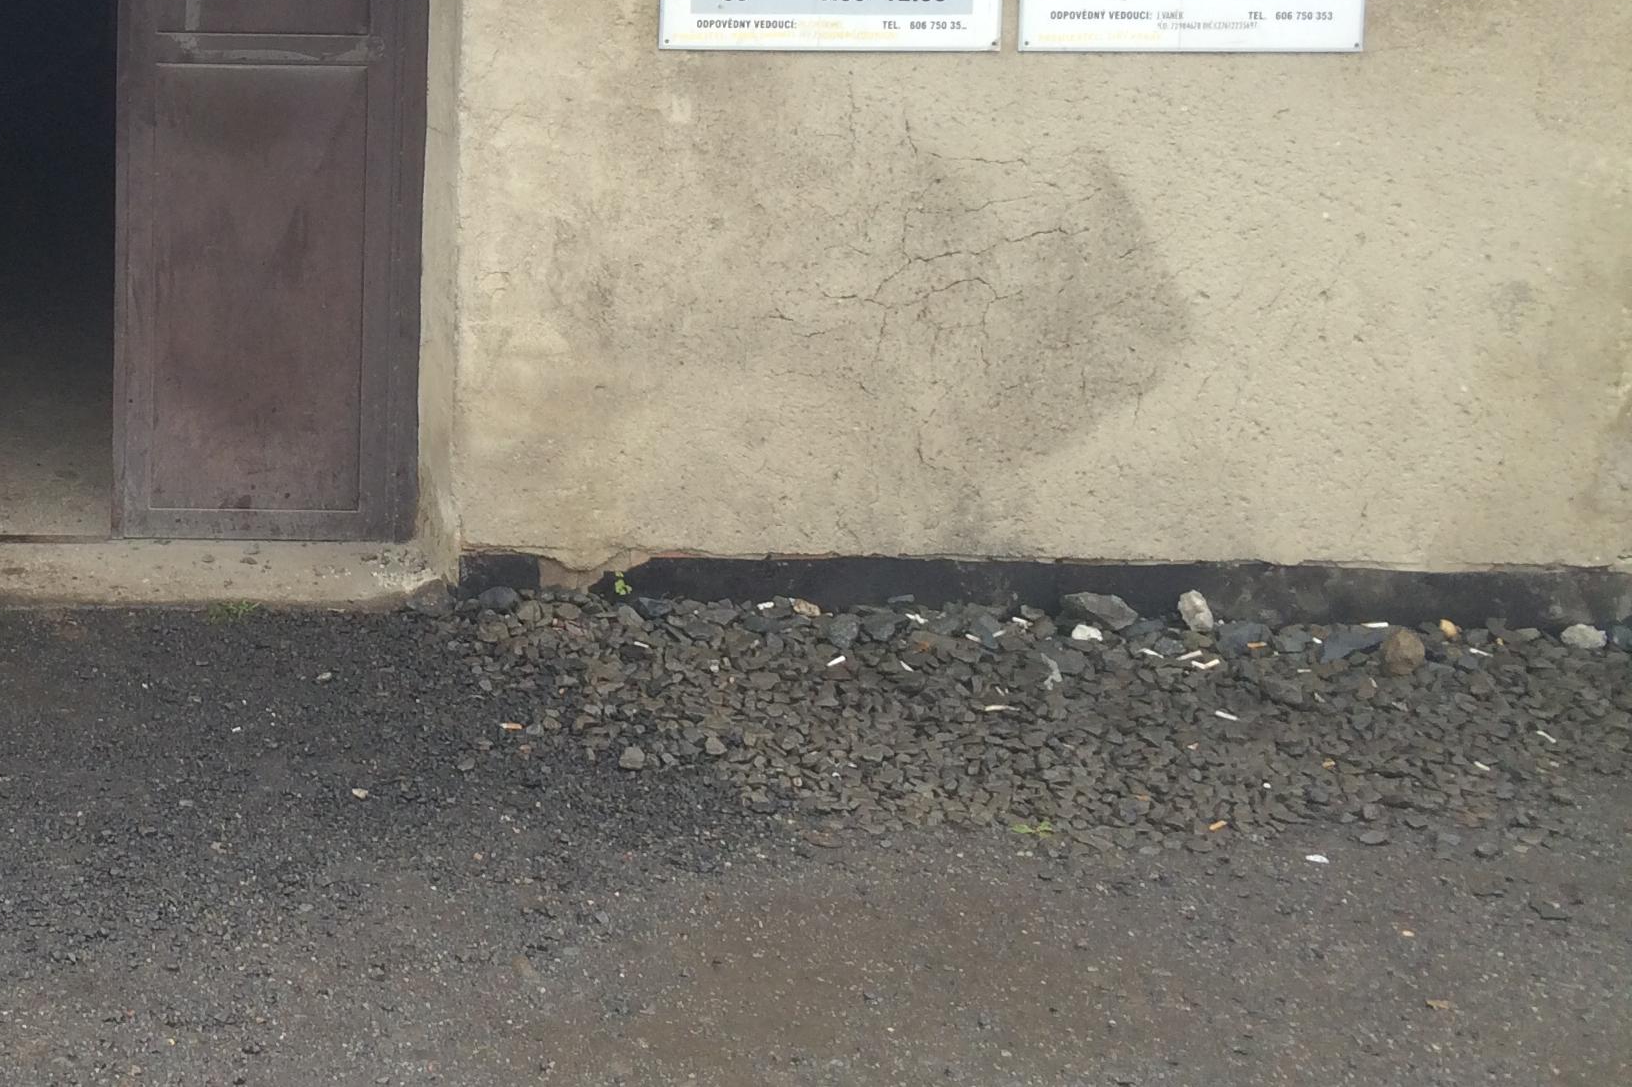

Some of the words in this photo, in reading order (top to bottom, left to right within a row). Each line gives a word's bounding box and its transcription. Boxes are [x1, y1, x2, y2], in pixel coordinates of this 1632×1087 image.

[1275, 11, 1293, 20] 606
[1296, 11, 1313, 20] 750
[1316, 11, 1333, 20] 353
[882, 20, 901, 30] TEL.
[930, 20, 947, 30] 750
